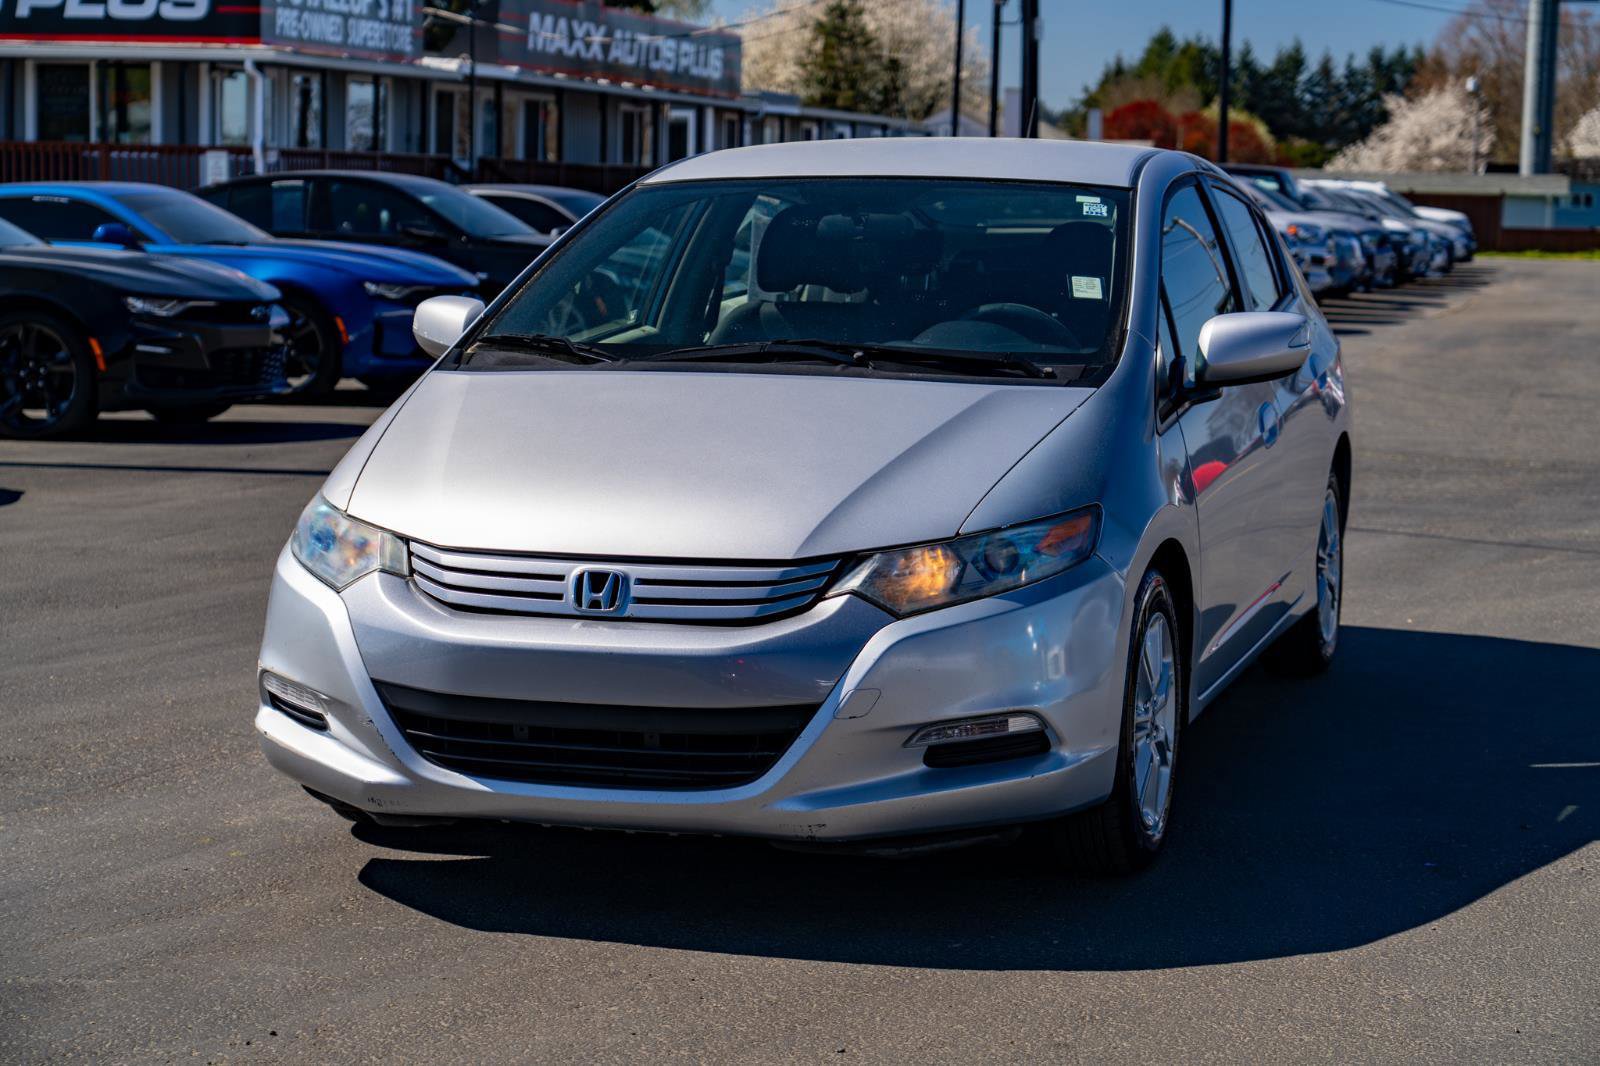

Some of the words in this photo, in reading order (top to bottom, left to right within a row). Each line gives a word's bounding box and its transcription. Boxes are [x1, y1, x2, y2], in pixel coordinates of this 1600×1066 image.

[275, 6, 344, 43] PRE-OWNED
[347, 17, 413, 51] SUPERSTORE
[527, 12, 607, 62] MAXX
[607, 29, 677, 73] AUTOS
[677, 40, 724, 80] PLUS
